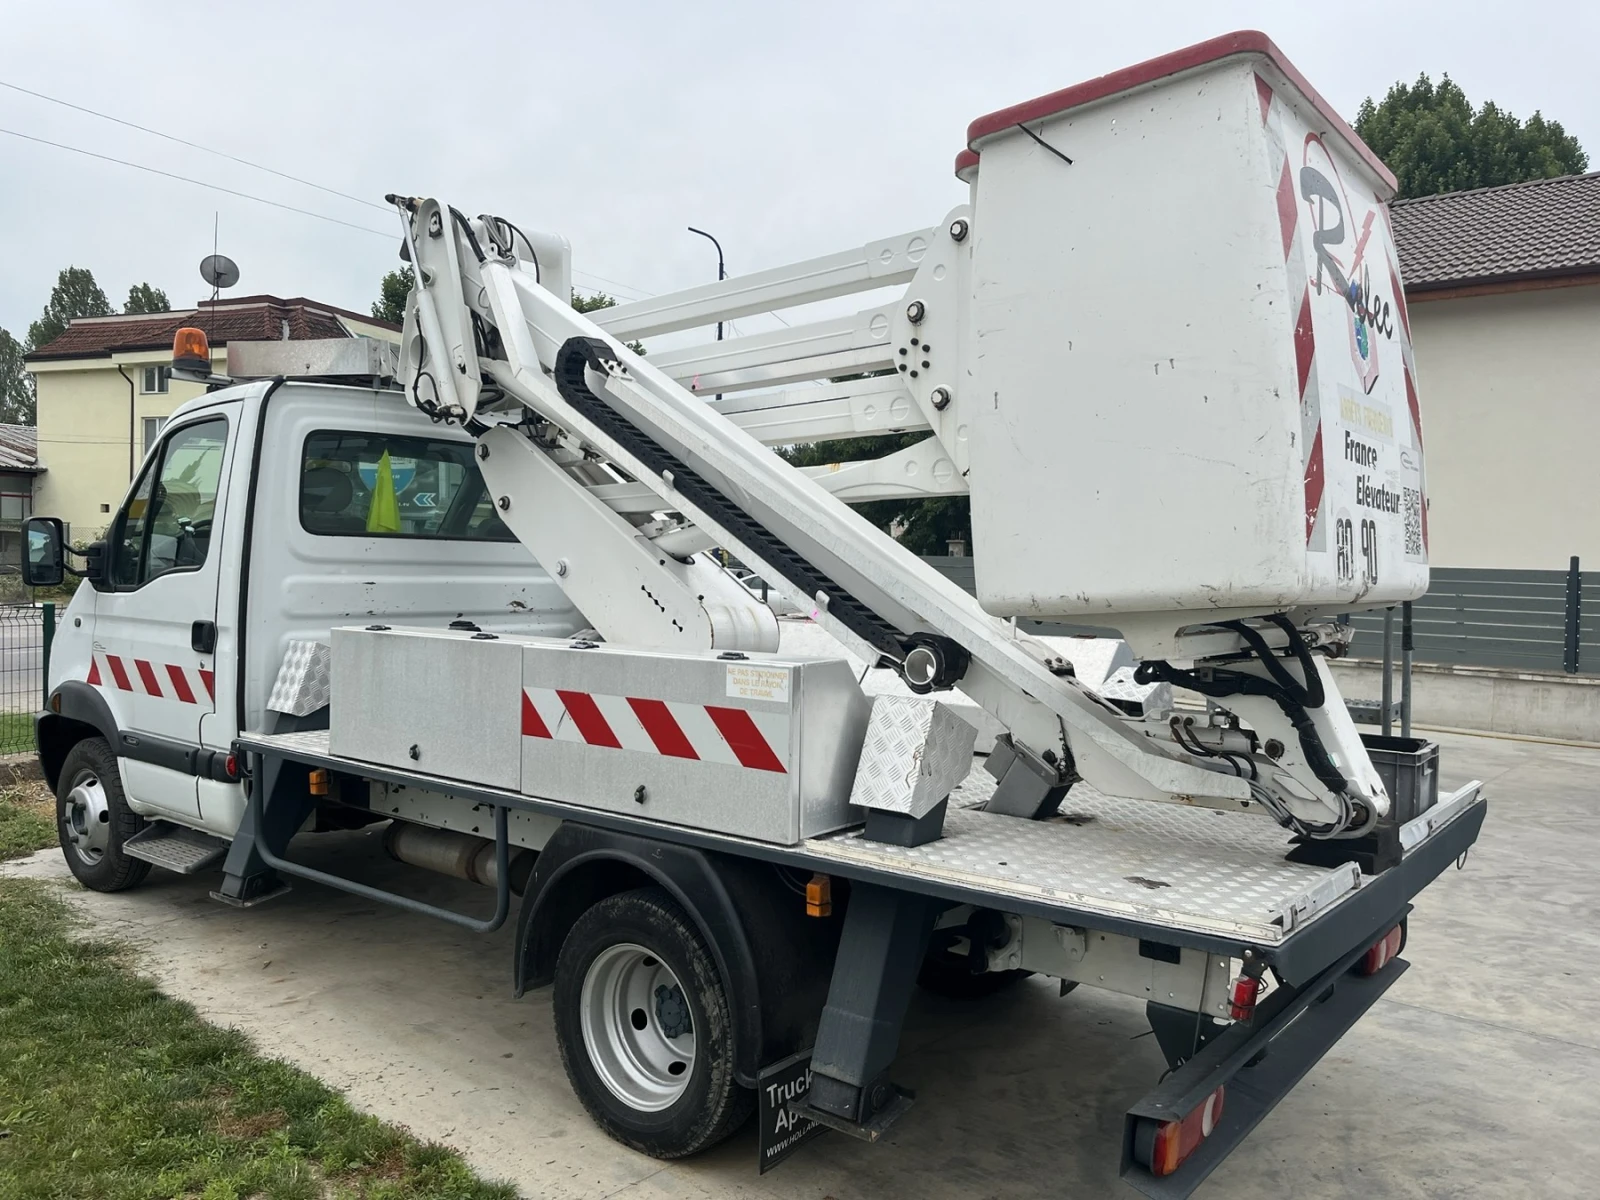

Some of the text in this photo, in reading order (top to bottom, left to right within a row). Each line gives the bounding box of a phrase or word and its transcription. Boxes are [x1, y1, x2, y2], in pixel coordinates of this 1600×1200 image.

[1344, 429, 1377, 470] France
[1356, 474, 1400, 514] Elévateur
[738, 668, 749, 677] PAS
[740, 687, 748, 695] DE
[775, 1108, 804, 1134] Ap
